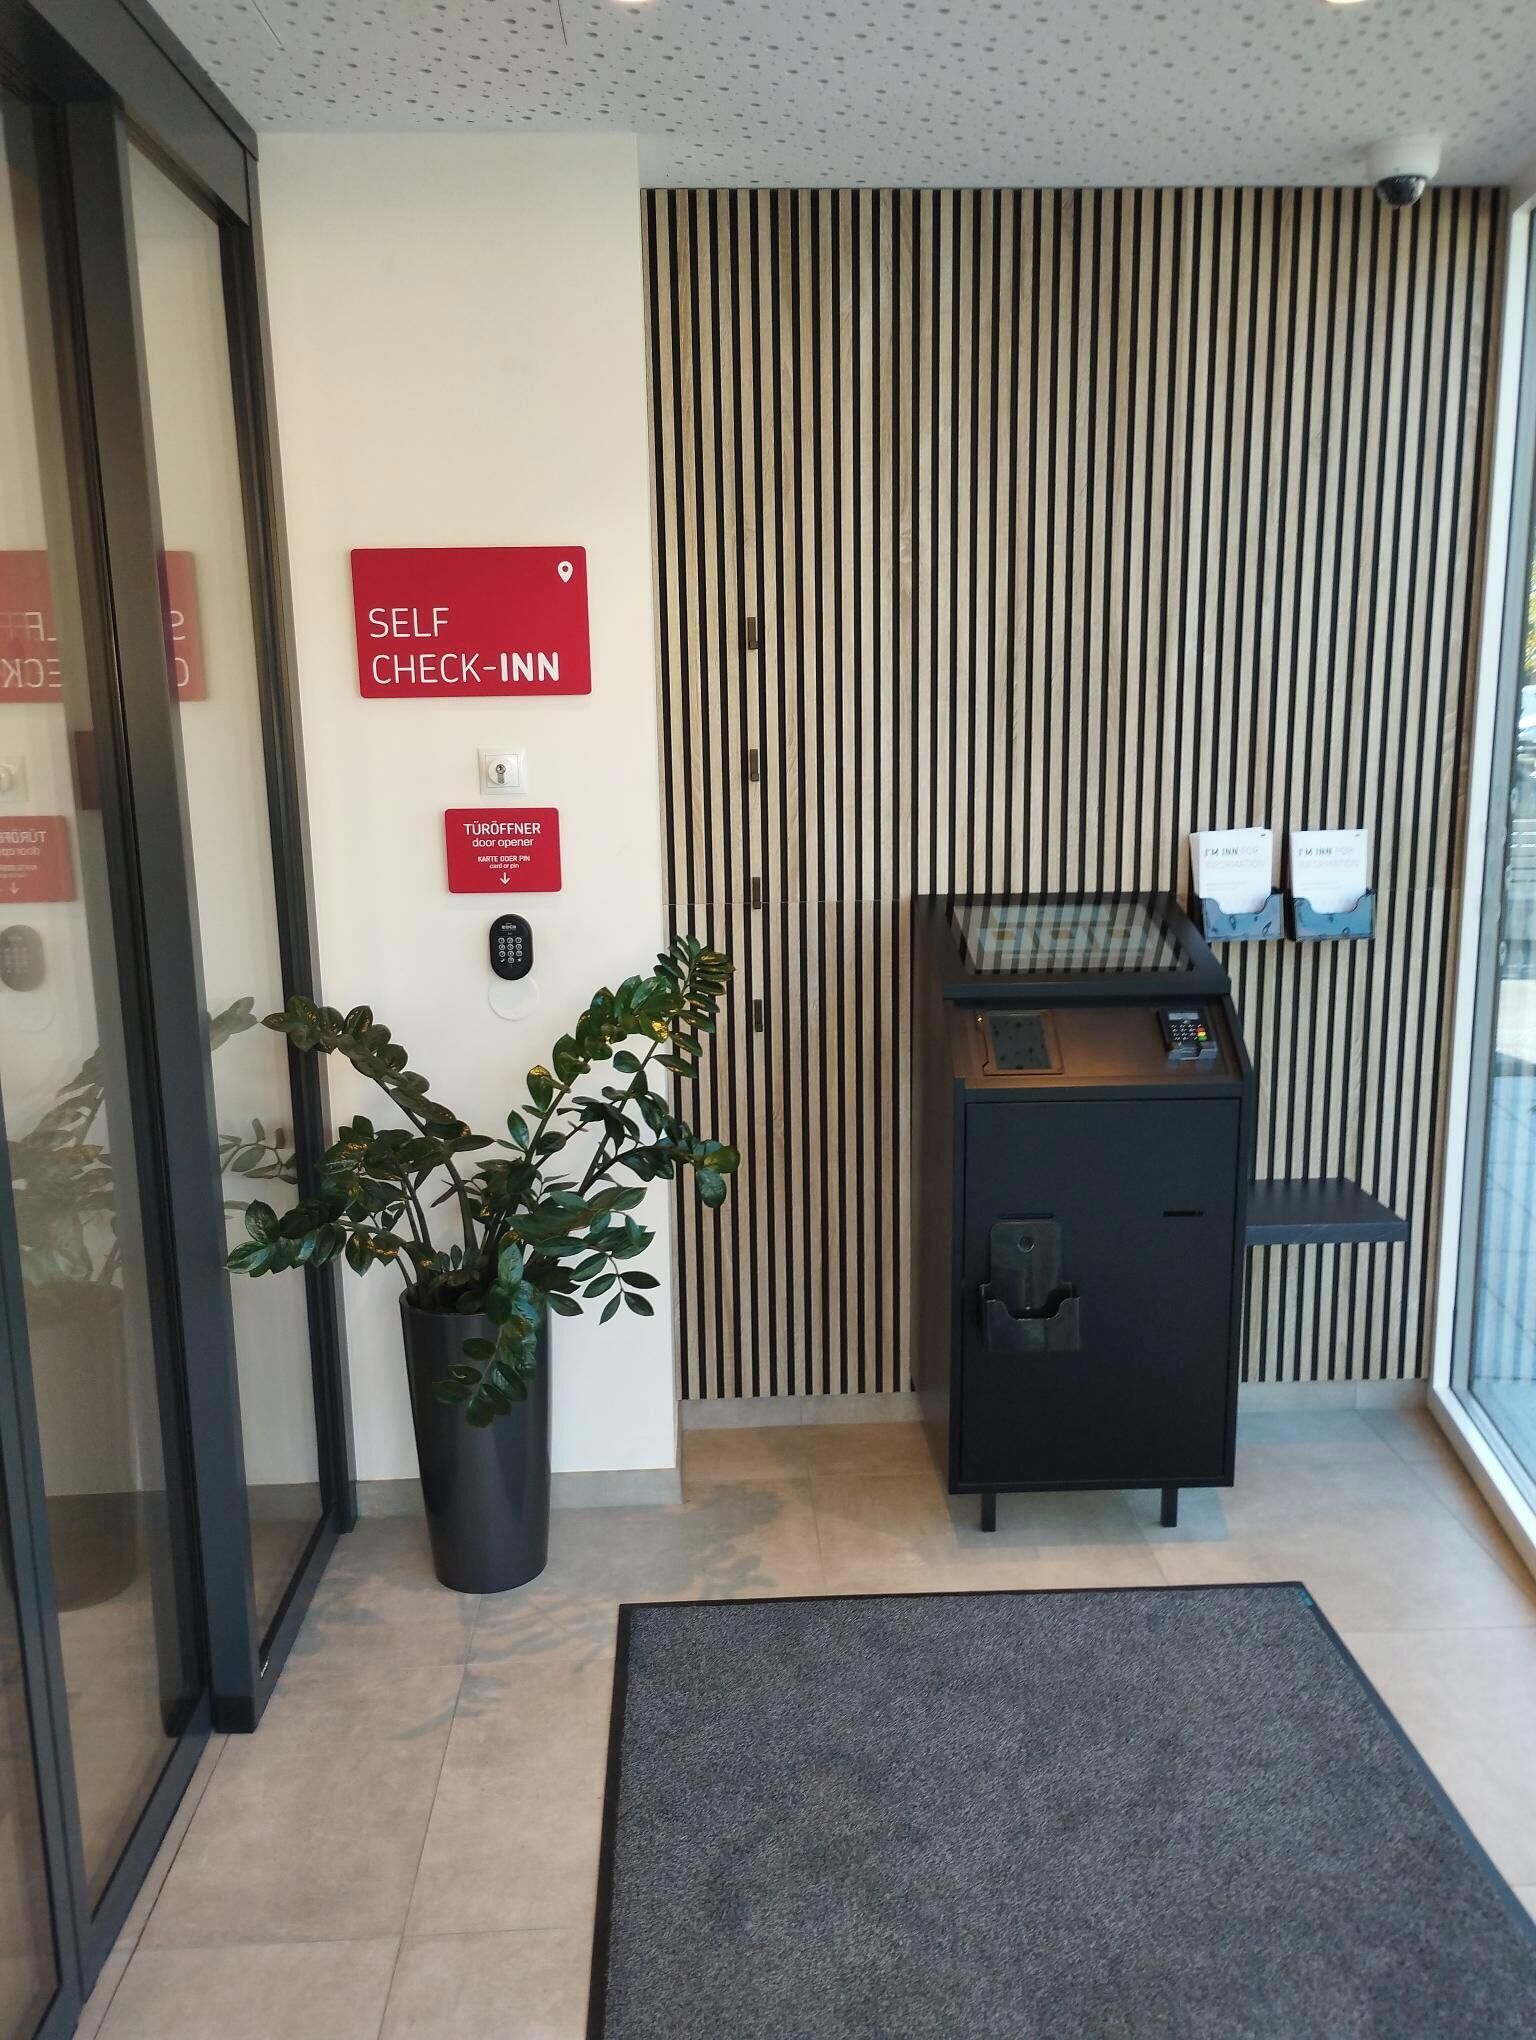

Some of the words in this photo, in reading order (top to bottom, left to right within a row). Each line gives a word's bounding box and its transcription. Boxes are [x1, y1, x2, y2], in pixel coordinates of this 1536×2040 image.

[368, 607, 449, 638] SELF
[372, 651, 560, 684] CHECK-INN
[463, 820, 541, 835] TÜRÖFFNER
[472, 838, 496, 847] door
[498, 838, 534, 848] opener
